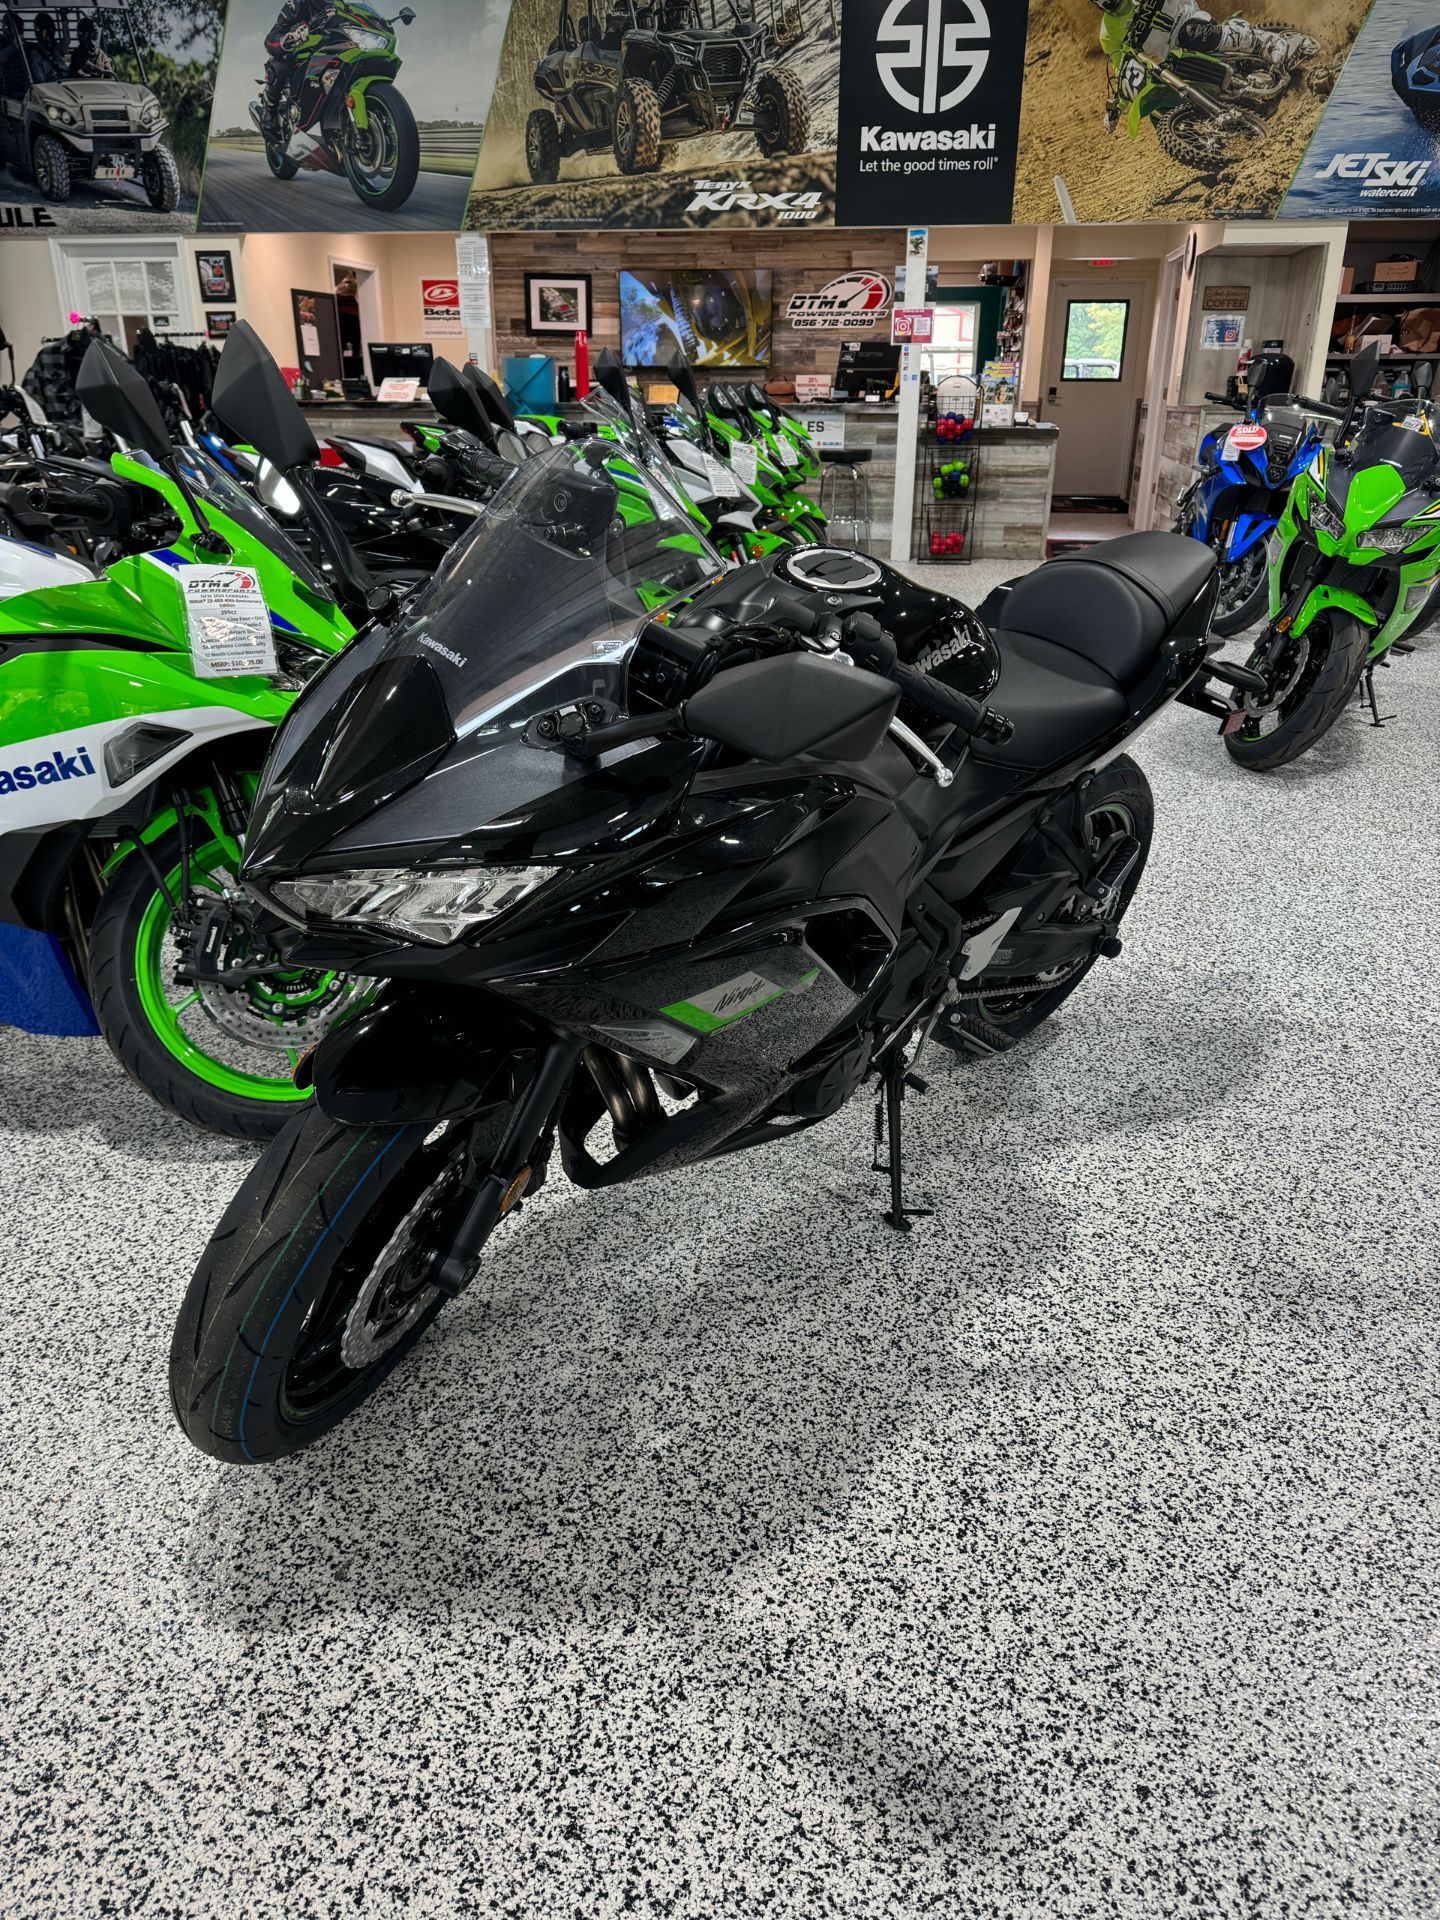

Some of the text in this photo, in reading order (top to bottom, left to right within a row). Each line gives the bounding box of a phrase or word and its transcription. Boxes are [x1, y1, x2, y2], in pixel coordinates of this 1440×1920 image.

[860, 124, 996, 151] Kawasaki
[859, 160, 878, 172] Let
[881, 159, 900, 172] the
[904, 158, 935, 175] good
[938, 158, 970, 171] times
[1314, 153, 1390, 178] JET
[1360, 187, 1418, 197] watercraft
[685, 192, 822, 211] KRX4
[777, 211, 817, 219] 1000
[790, 296, 838, 309] DTM
[1206, 299, 1245, 308] COFFEE
[1236, 426, 1260, 434] SOLD
[188, 580, 222, 588] DTM
[417, 632, 468, 667] Kawasaki
[712, 978, 766, 1013] Ninja
